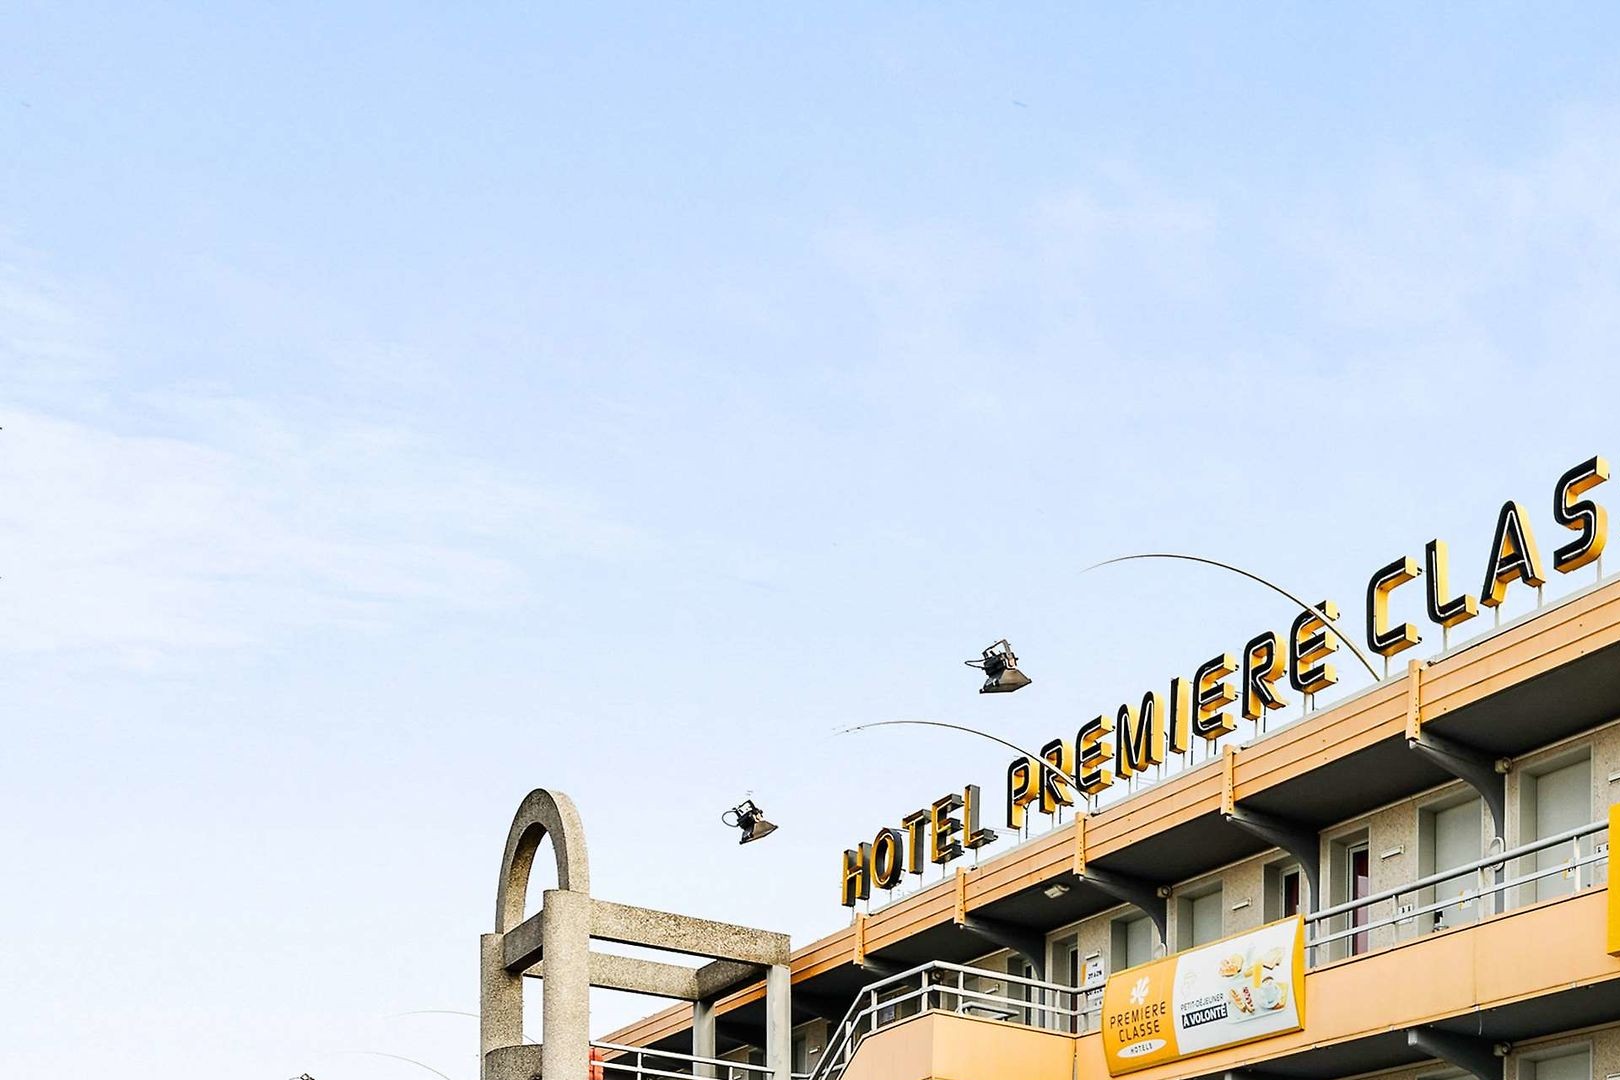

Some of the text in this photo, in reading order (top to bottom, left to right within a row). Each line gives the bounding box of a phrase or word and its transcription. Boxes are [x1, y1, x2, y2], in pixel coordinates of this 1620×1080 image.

[841, 783, 998, 908] HOTEL
[1006, 599, 1340, 830] PREMIERE
[1109, 1000, 1167, 1029] PREMIERE
[1119, 1019, 1161, 1044] CLASSE
